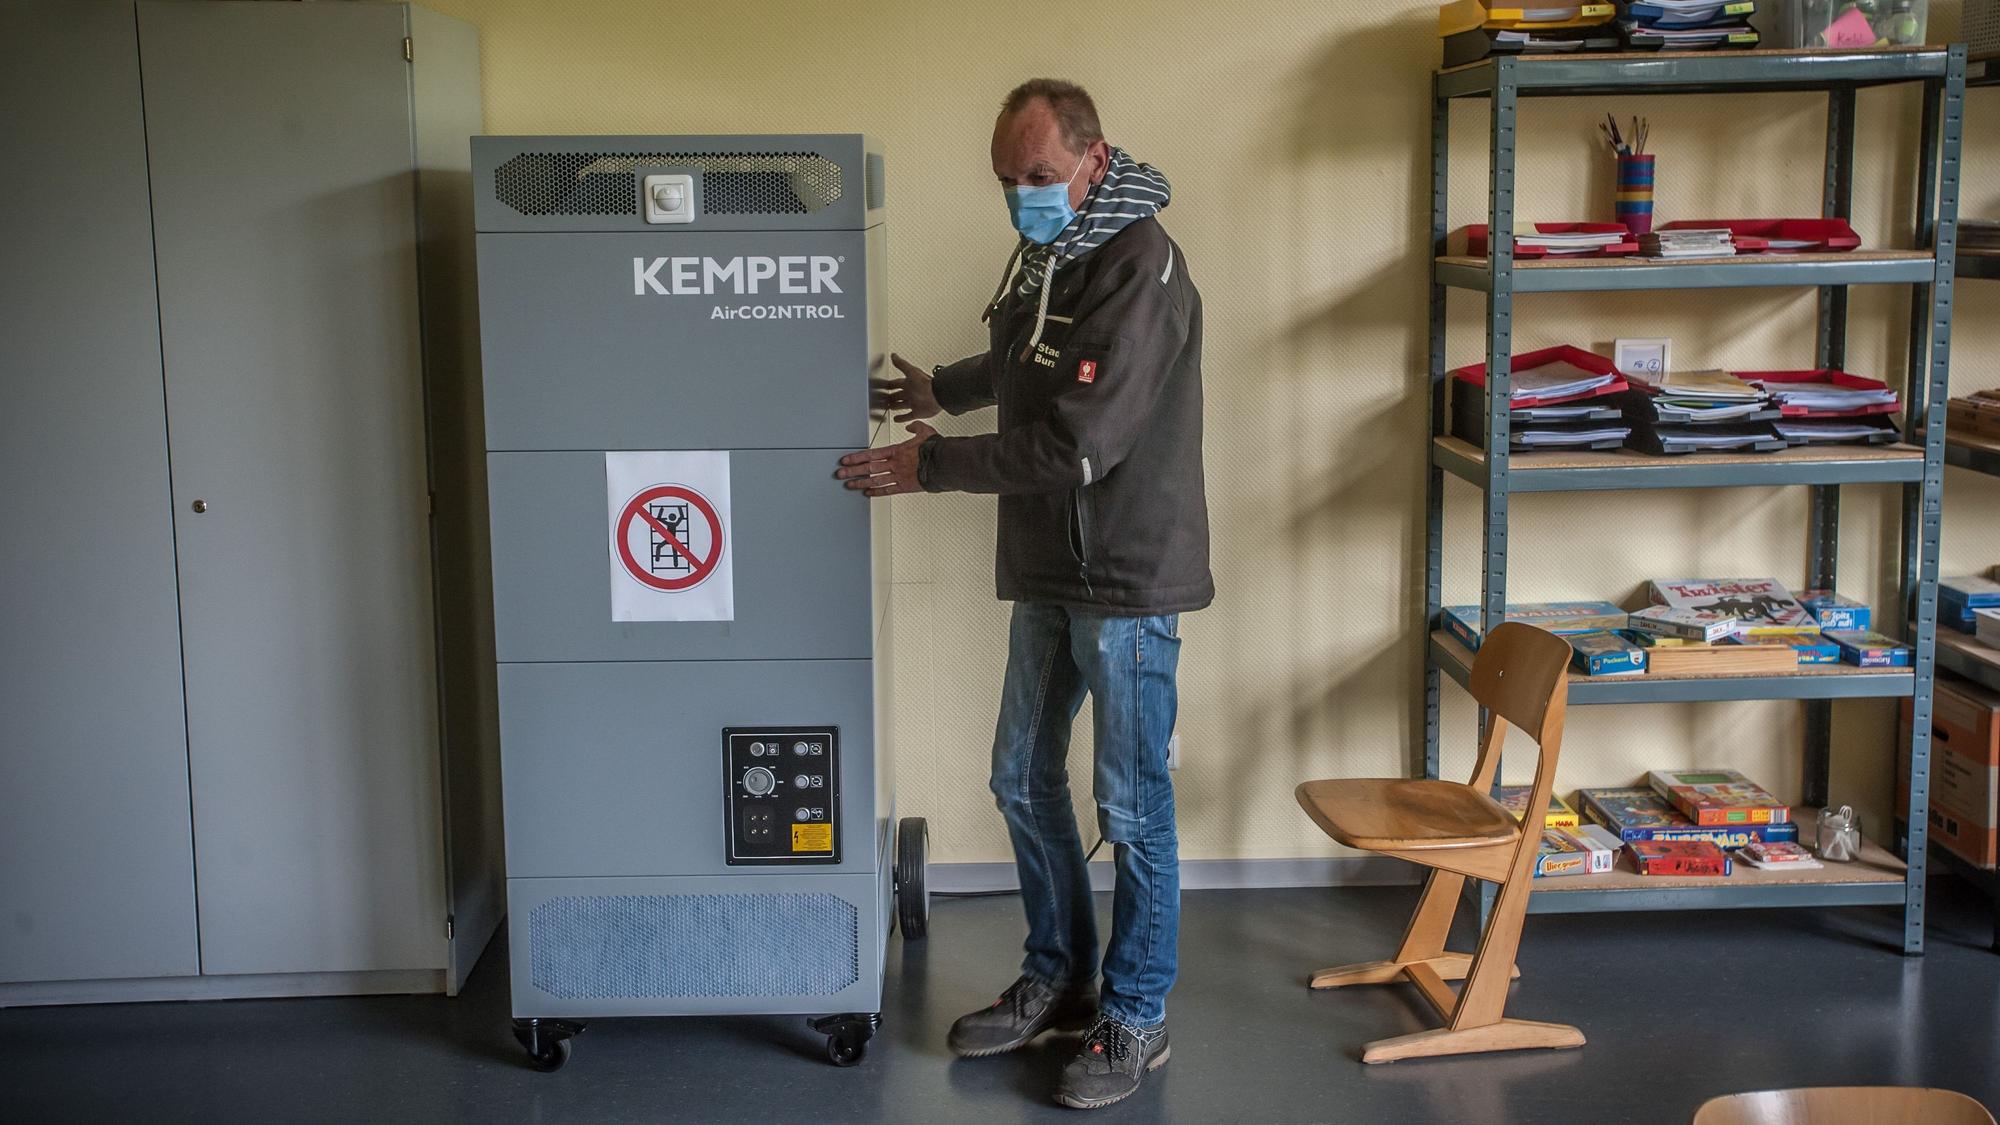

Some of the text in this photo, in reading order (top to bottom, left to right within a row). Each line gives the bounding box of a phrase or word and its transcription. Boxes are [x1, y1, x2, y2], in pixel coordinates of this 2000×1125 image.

[633, 255, 844, 296] KEMPER
[710, 305, 845, 320] AirCO2NTROL
[1667, 582, 1772, 598] Twister
[1862, 656, 1891, 665] memory
